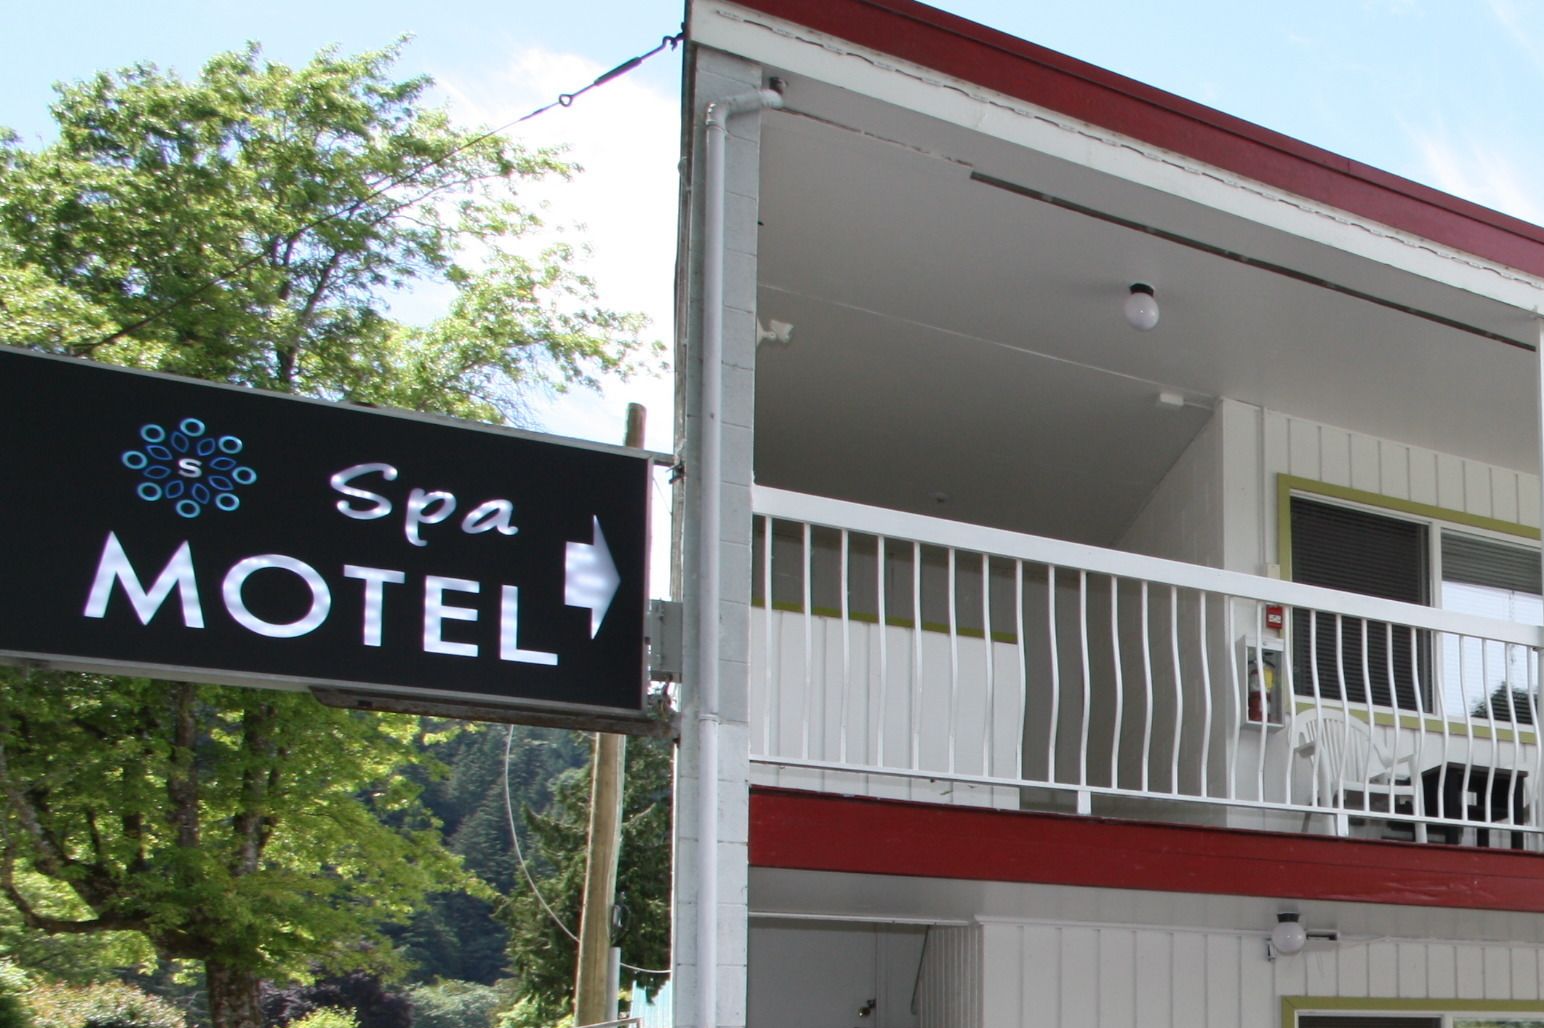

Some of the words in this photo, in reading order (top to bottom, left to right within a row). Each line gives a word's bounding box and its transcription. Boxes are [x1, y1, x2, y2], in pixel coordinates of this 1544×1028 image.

[178, 458, 202, 478] S
[330, 462, 518, 547] Spa
[83, 531, 558, 666] MOTEL
